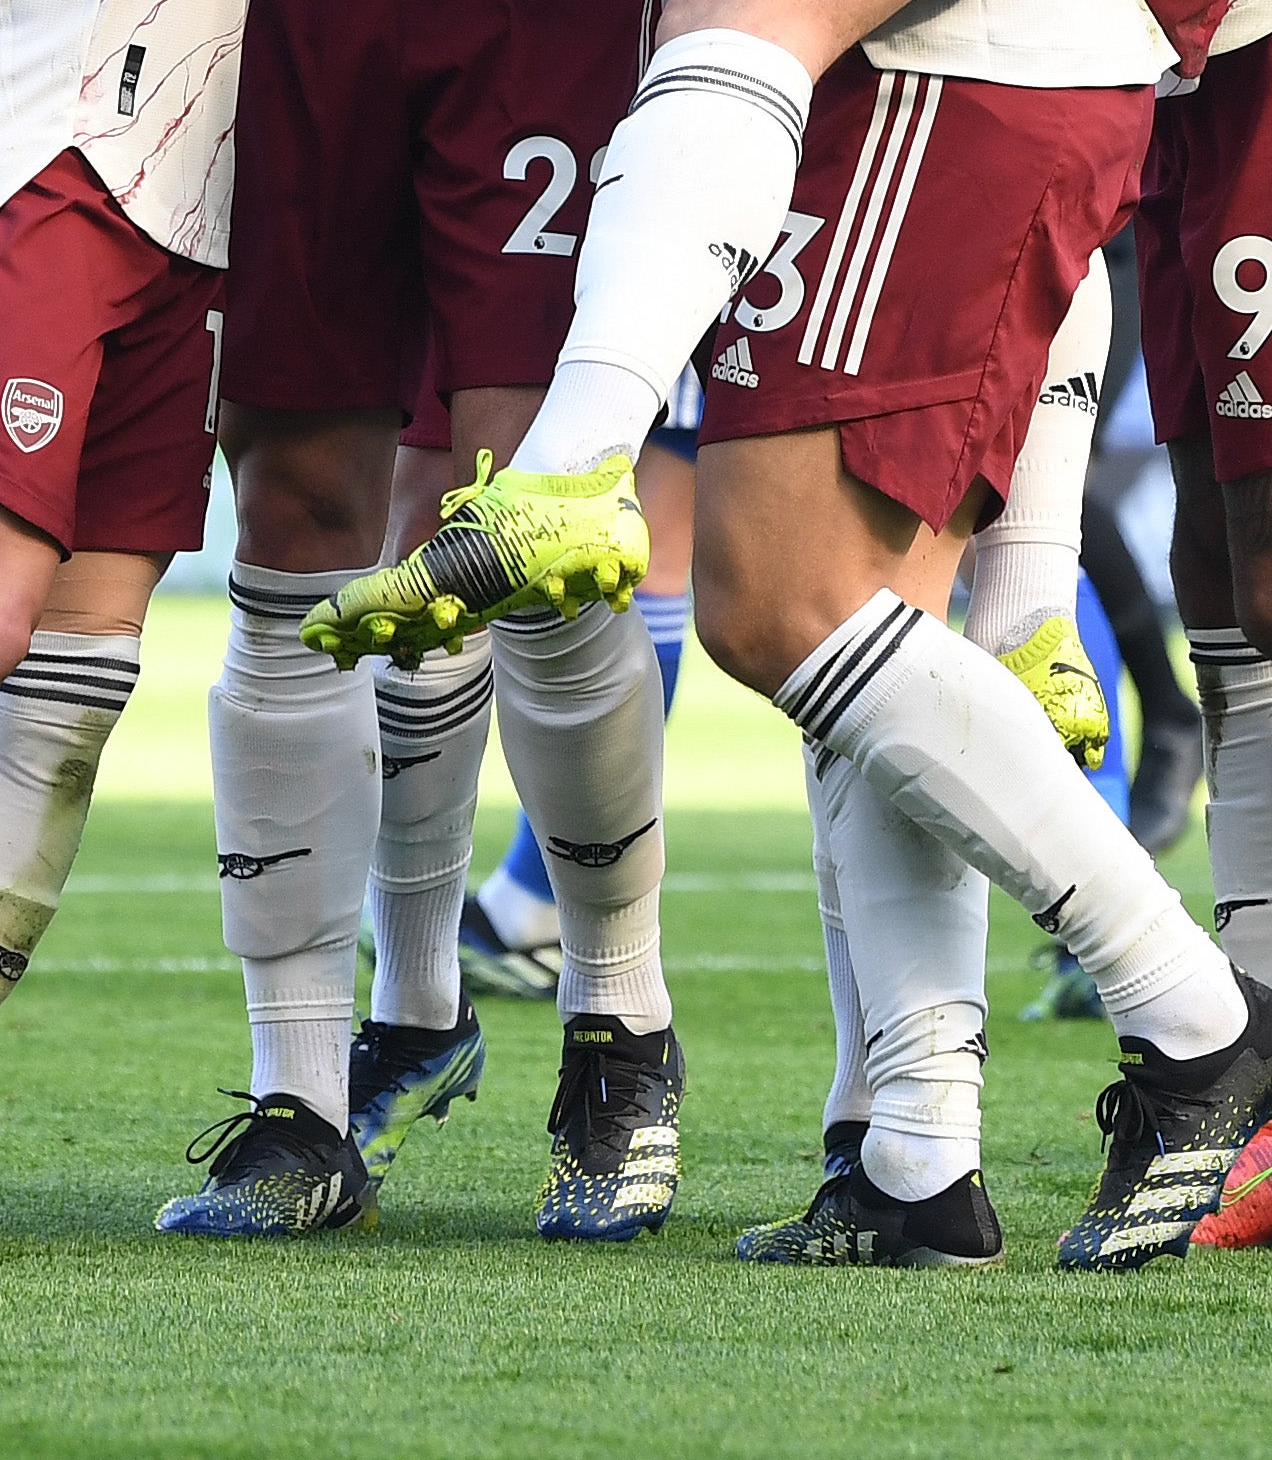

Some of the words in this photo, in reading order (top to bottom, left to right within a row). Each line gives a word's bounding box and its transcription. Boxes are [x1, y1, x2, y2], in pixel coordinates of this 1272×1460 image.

[502, 136, 609, 256] 2
[711, 363, 760, 388] adidas
[13, 389, 54, 410] Arsenal
